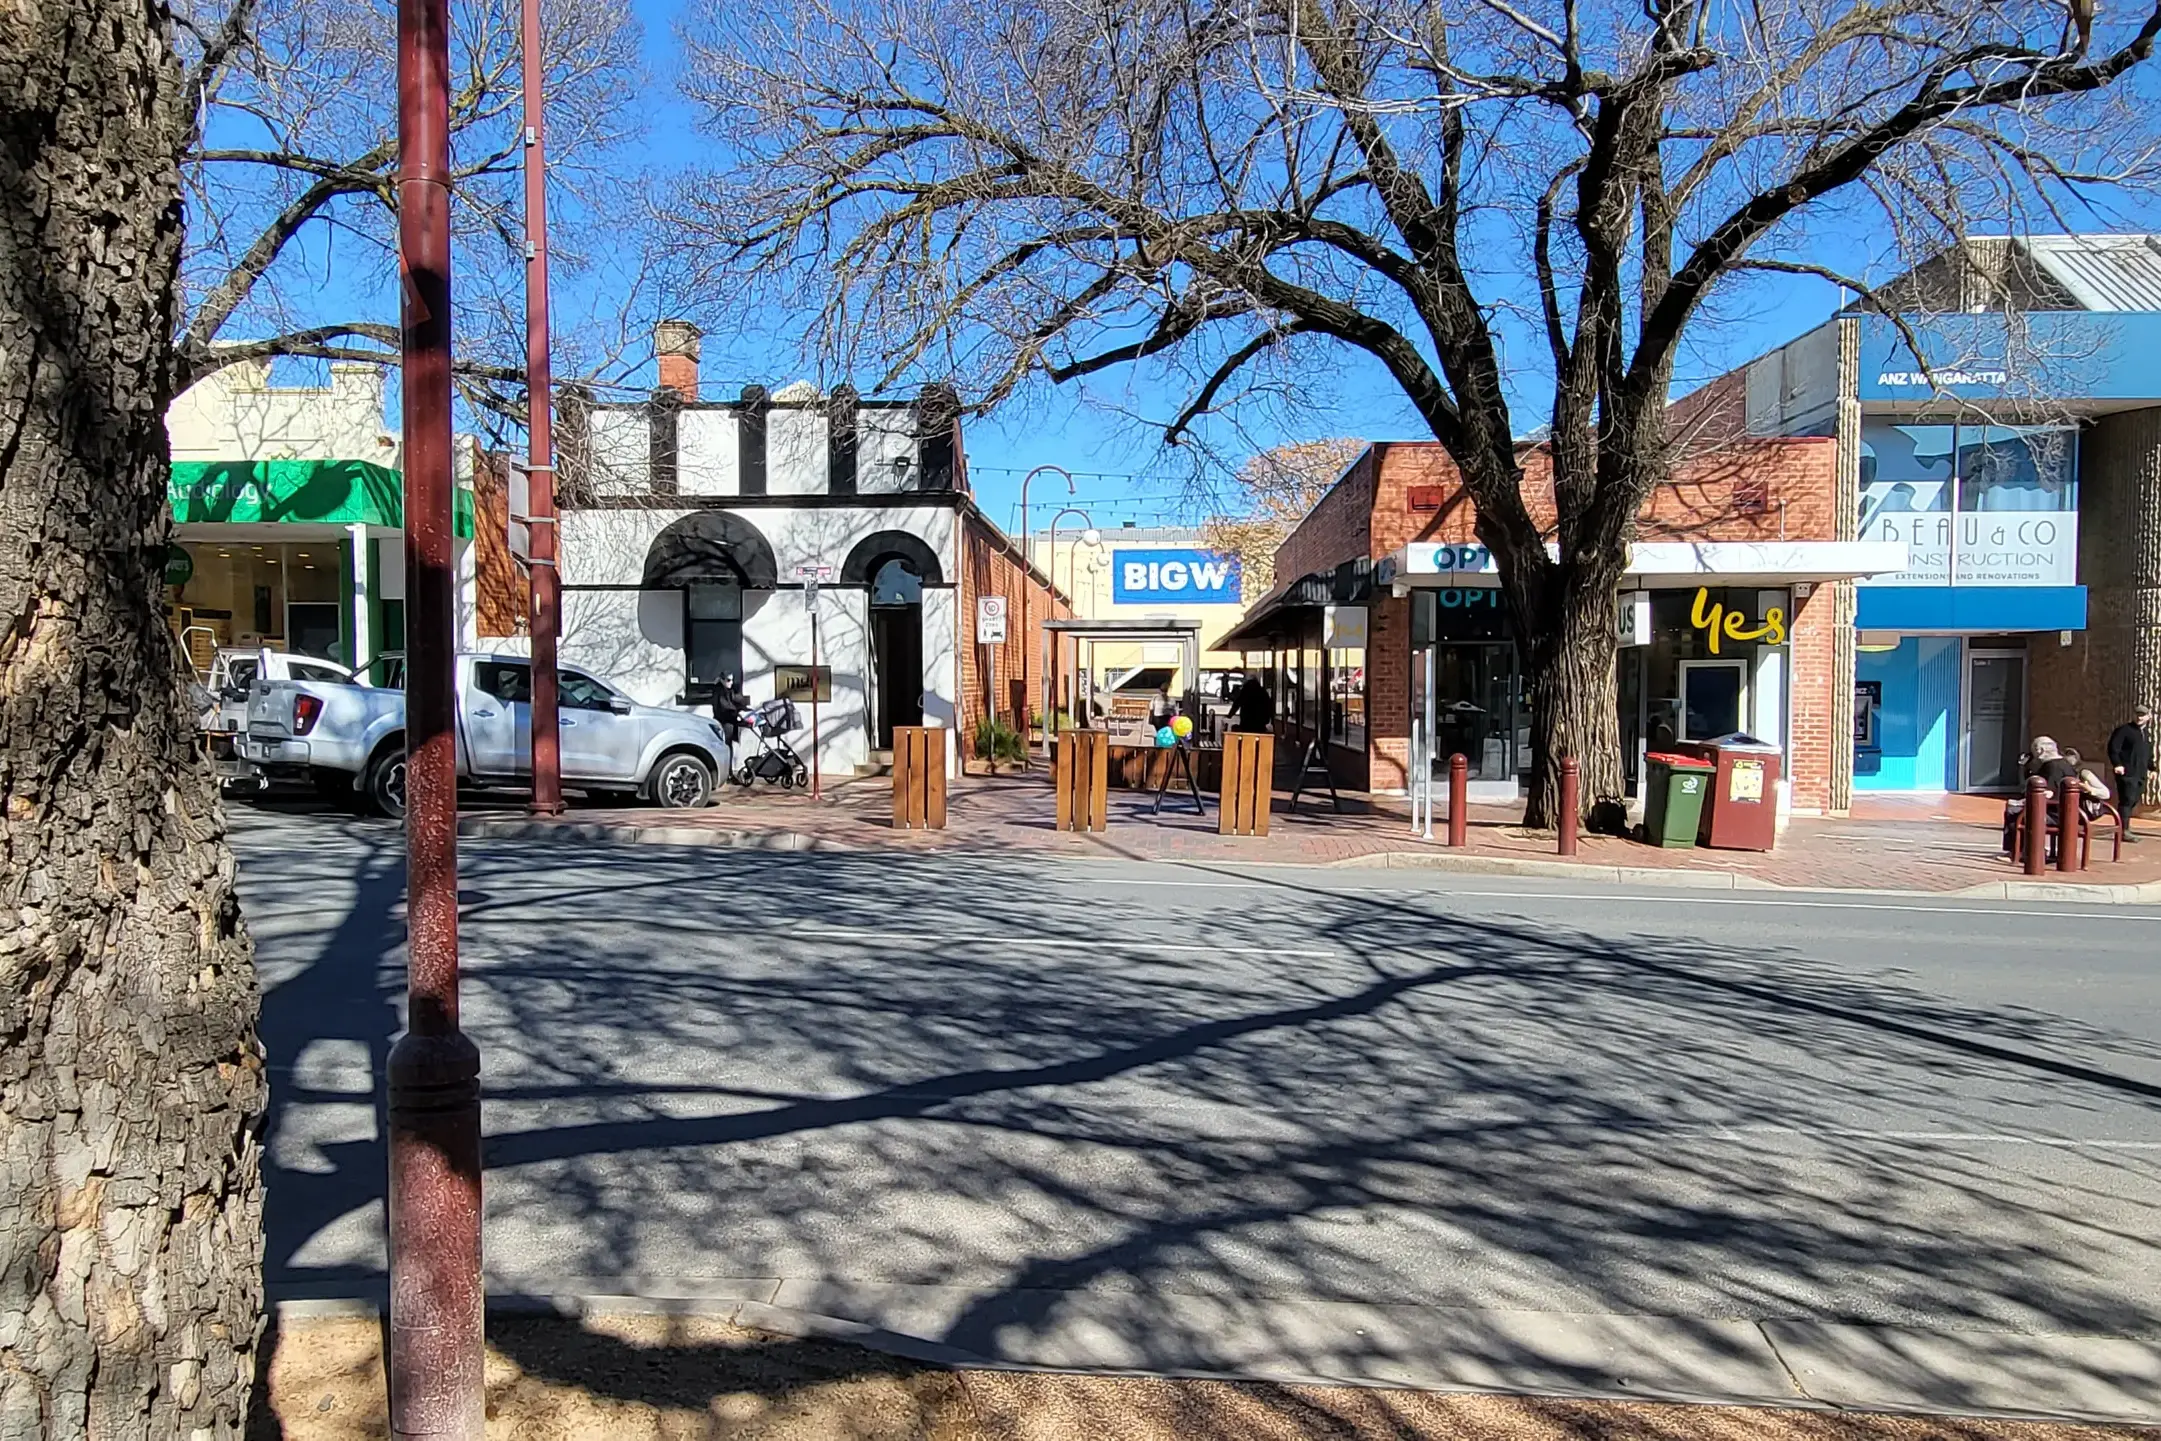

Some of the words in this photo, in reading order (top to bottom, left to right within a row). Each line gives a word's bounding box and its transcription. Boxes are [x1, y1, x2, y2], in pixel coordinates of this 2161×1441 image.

[1878, 372, 1908, 385] ANZ
[167, 480, 272, 504] Audiology
[1883, 517, 1978, 546] BEAU
[1991, 525, 2005, 546] &
[2018, 520, 2057, 546] CO
[1433, 547, 1491, 569] OPT
[1908, 552, 2054, 566] NSRUCTION
[1618, 605, 1634, 635] US
